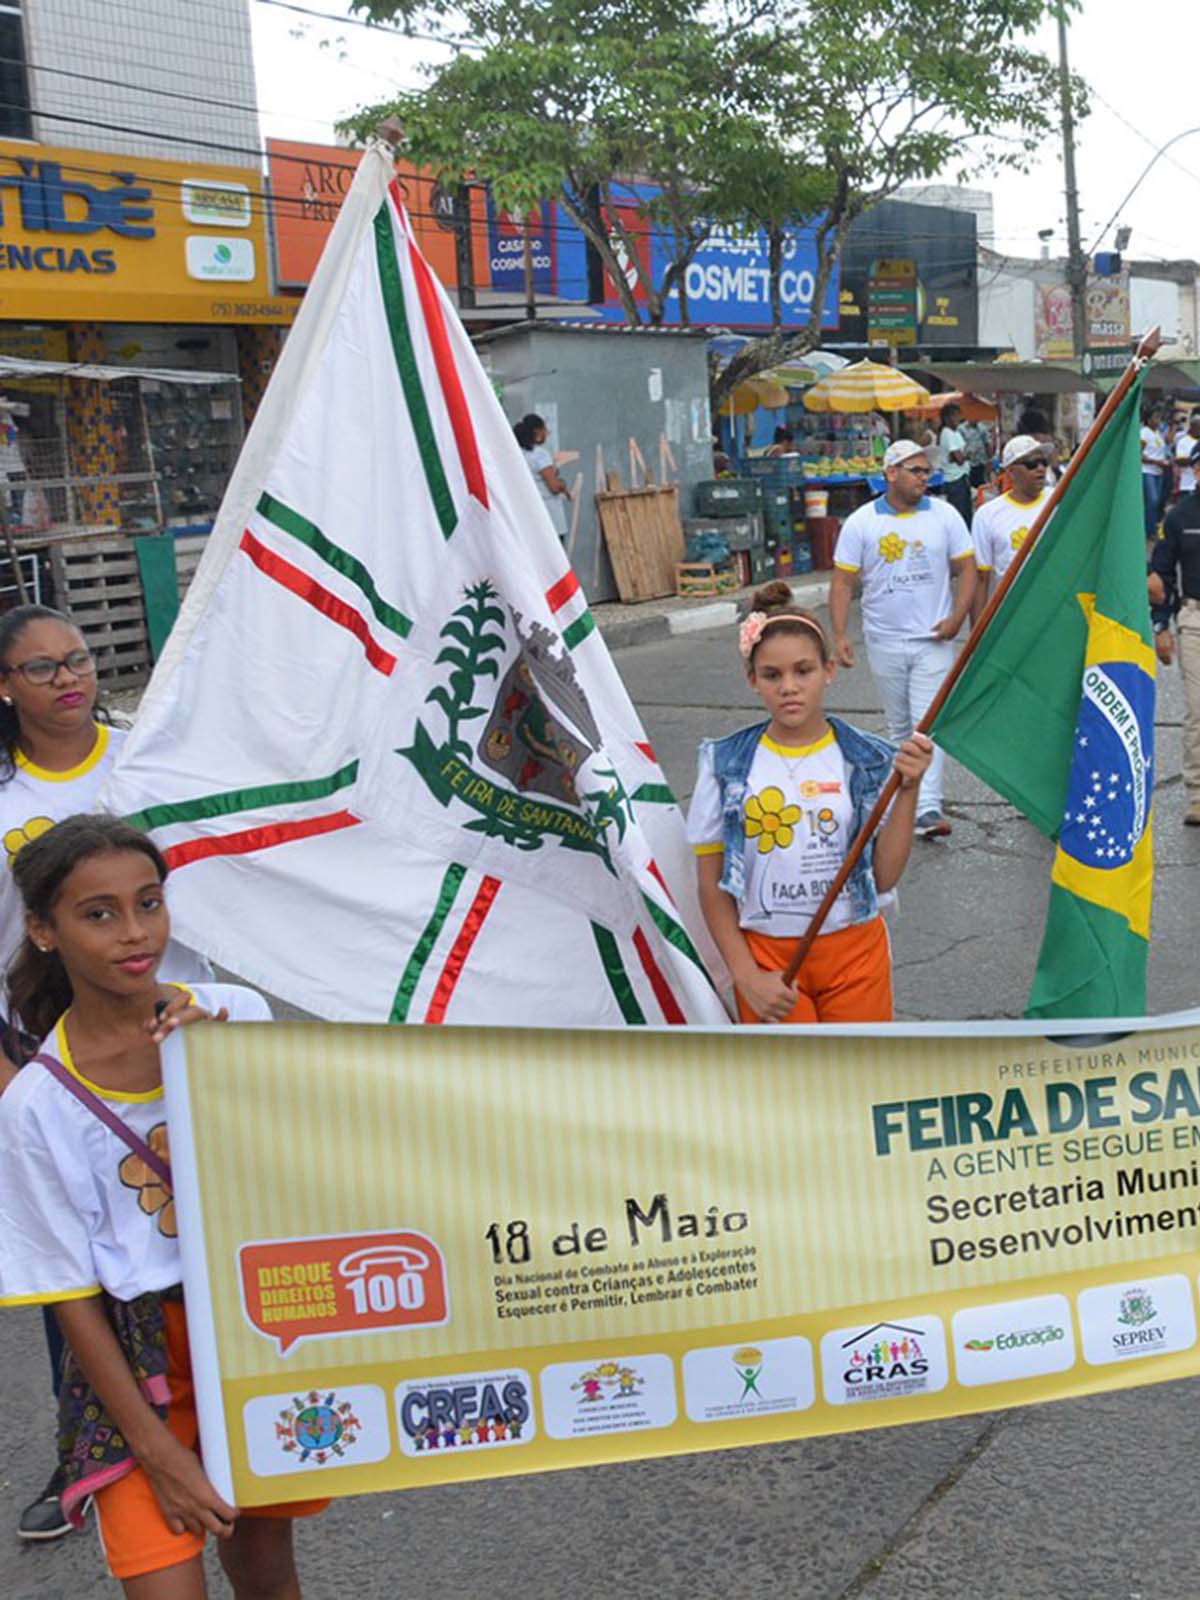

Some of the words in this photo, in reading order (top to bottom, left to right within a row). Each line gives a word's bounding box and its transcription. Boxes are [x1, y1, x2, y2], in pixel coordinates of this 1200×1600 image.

[1086, 672, 1130, 729] ORDEM
[1124, 726, 1136, 739] E
[441, 759, 496, 804] FEIRA
[497, 797, 517, 819] DE
[519, 802, 596, 841] SANTANA
[772, 882, 809, 900] FAÇA
[999, 1051, 1127, 1080] PREFEITURA
[872, 1087, 1036, 1156] FEIRA
[1045, 1076, 1123, 1135] DE
[927, 1157, 948, 1182] A
[953, 1142, 1052, 1178] GENTE
[1062, 1130, 1164, 1163] SEGUE
[927, 1174, 1106, 1225] Secretaria
[485, 1220, 531, 1264] 18
[552, 1222, 608, 1256] de
[624, 1193, 749, 1247] Maio
[258, 1262, 333, 1287] DISQUE
[346, 1272, 425, 1314] 100
[260, 1284, 336, 1306] DIREITOS
[494, 1274, 513, 1287] Dia
[515, 1269, 563, 1284] Nacional
[565, 1267, 578, 1279] de
[580, 1262, 629, 1277] Combate
[496, 1287, 542, 1303] Sexual
[544, 1282, 589, 1298] contra
[592, 1275, 650, 1294] Crianças
[667, 1261, 757, 1283] Adolescentes
[261, 1301, 337, 1324] HUMANOS
[497, 1302, 557, 1320] Esquecer
[559, 1300, 567, 1313] é
[571, 1293, 628, 1310] Permitir,
[631, 1288, 682, 1306] Lembrar
[685, 1284, 693, 1298] é
[696, 1276, 758, 1297] Combater
[996, 1325, 1065, 1351] Educação
[1111, 1325, 1167, 1348] SEPREV
[843, 1359, 929, 1384] CRAS
[402, 1381, 530, 1437] CREAS
